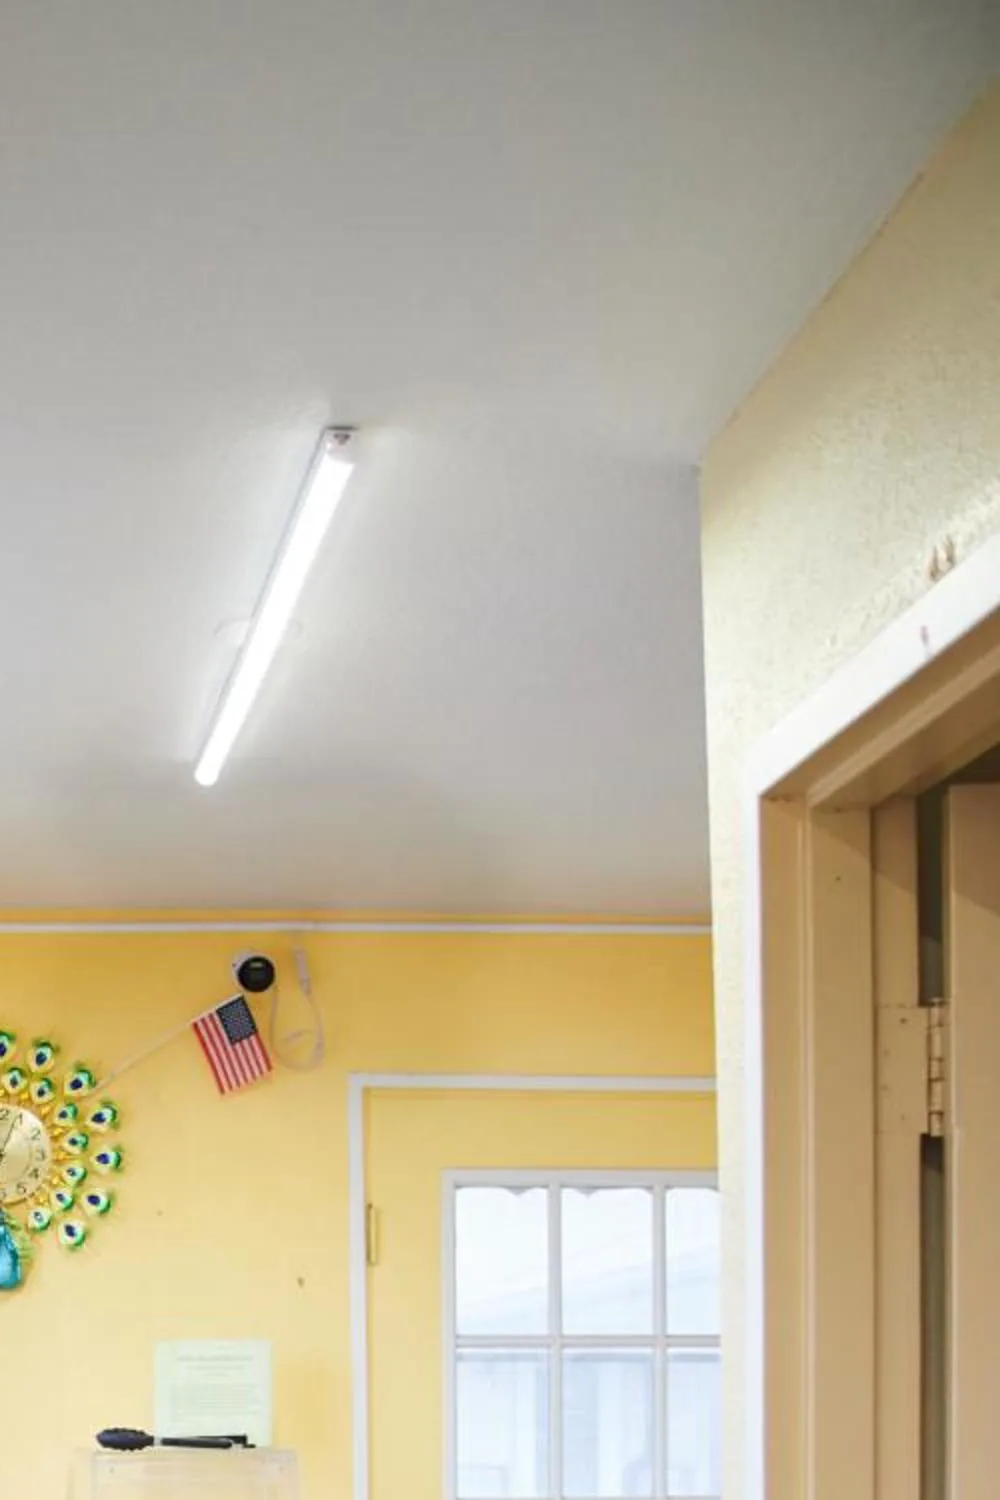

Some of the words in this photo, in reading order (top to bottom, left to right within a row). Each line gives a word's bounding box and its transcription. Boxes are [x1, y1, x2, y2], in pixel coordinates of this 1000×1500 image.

[30, 1127, 41, 1140] 2
[35, 1148, 46, 1162] 3
[28, 1168, 39, 1179] 4
[16, 1182, 27, 1194] 5
